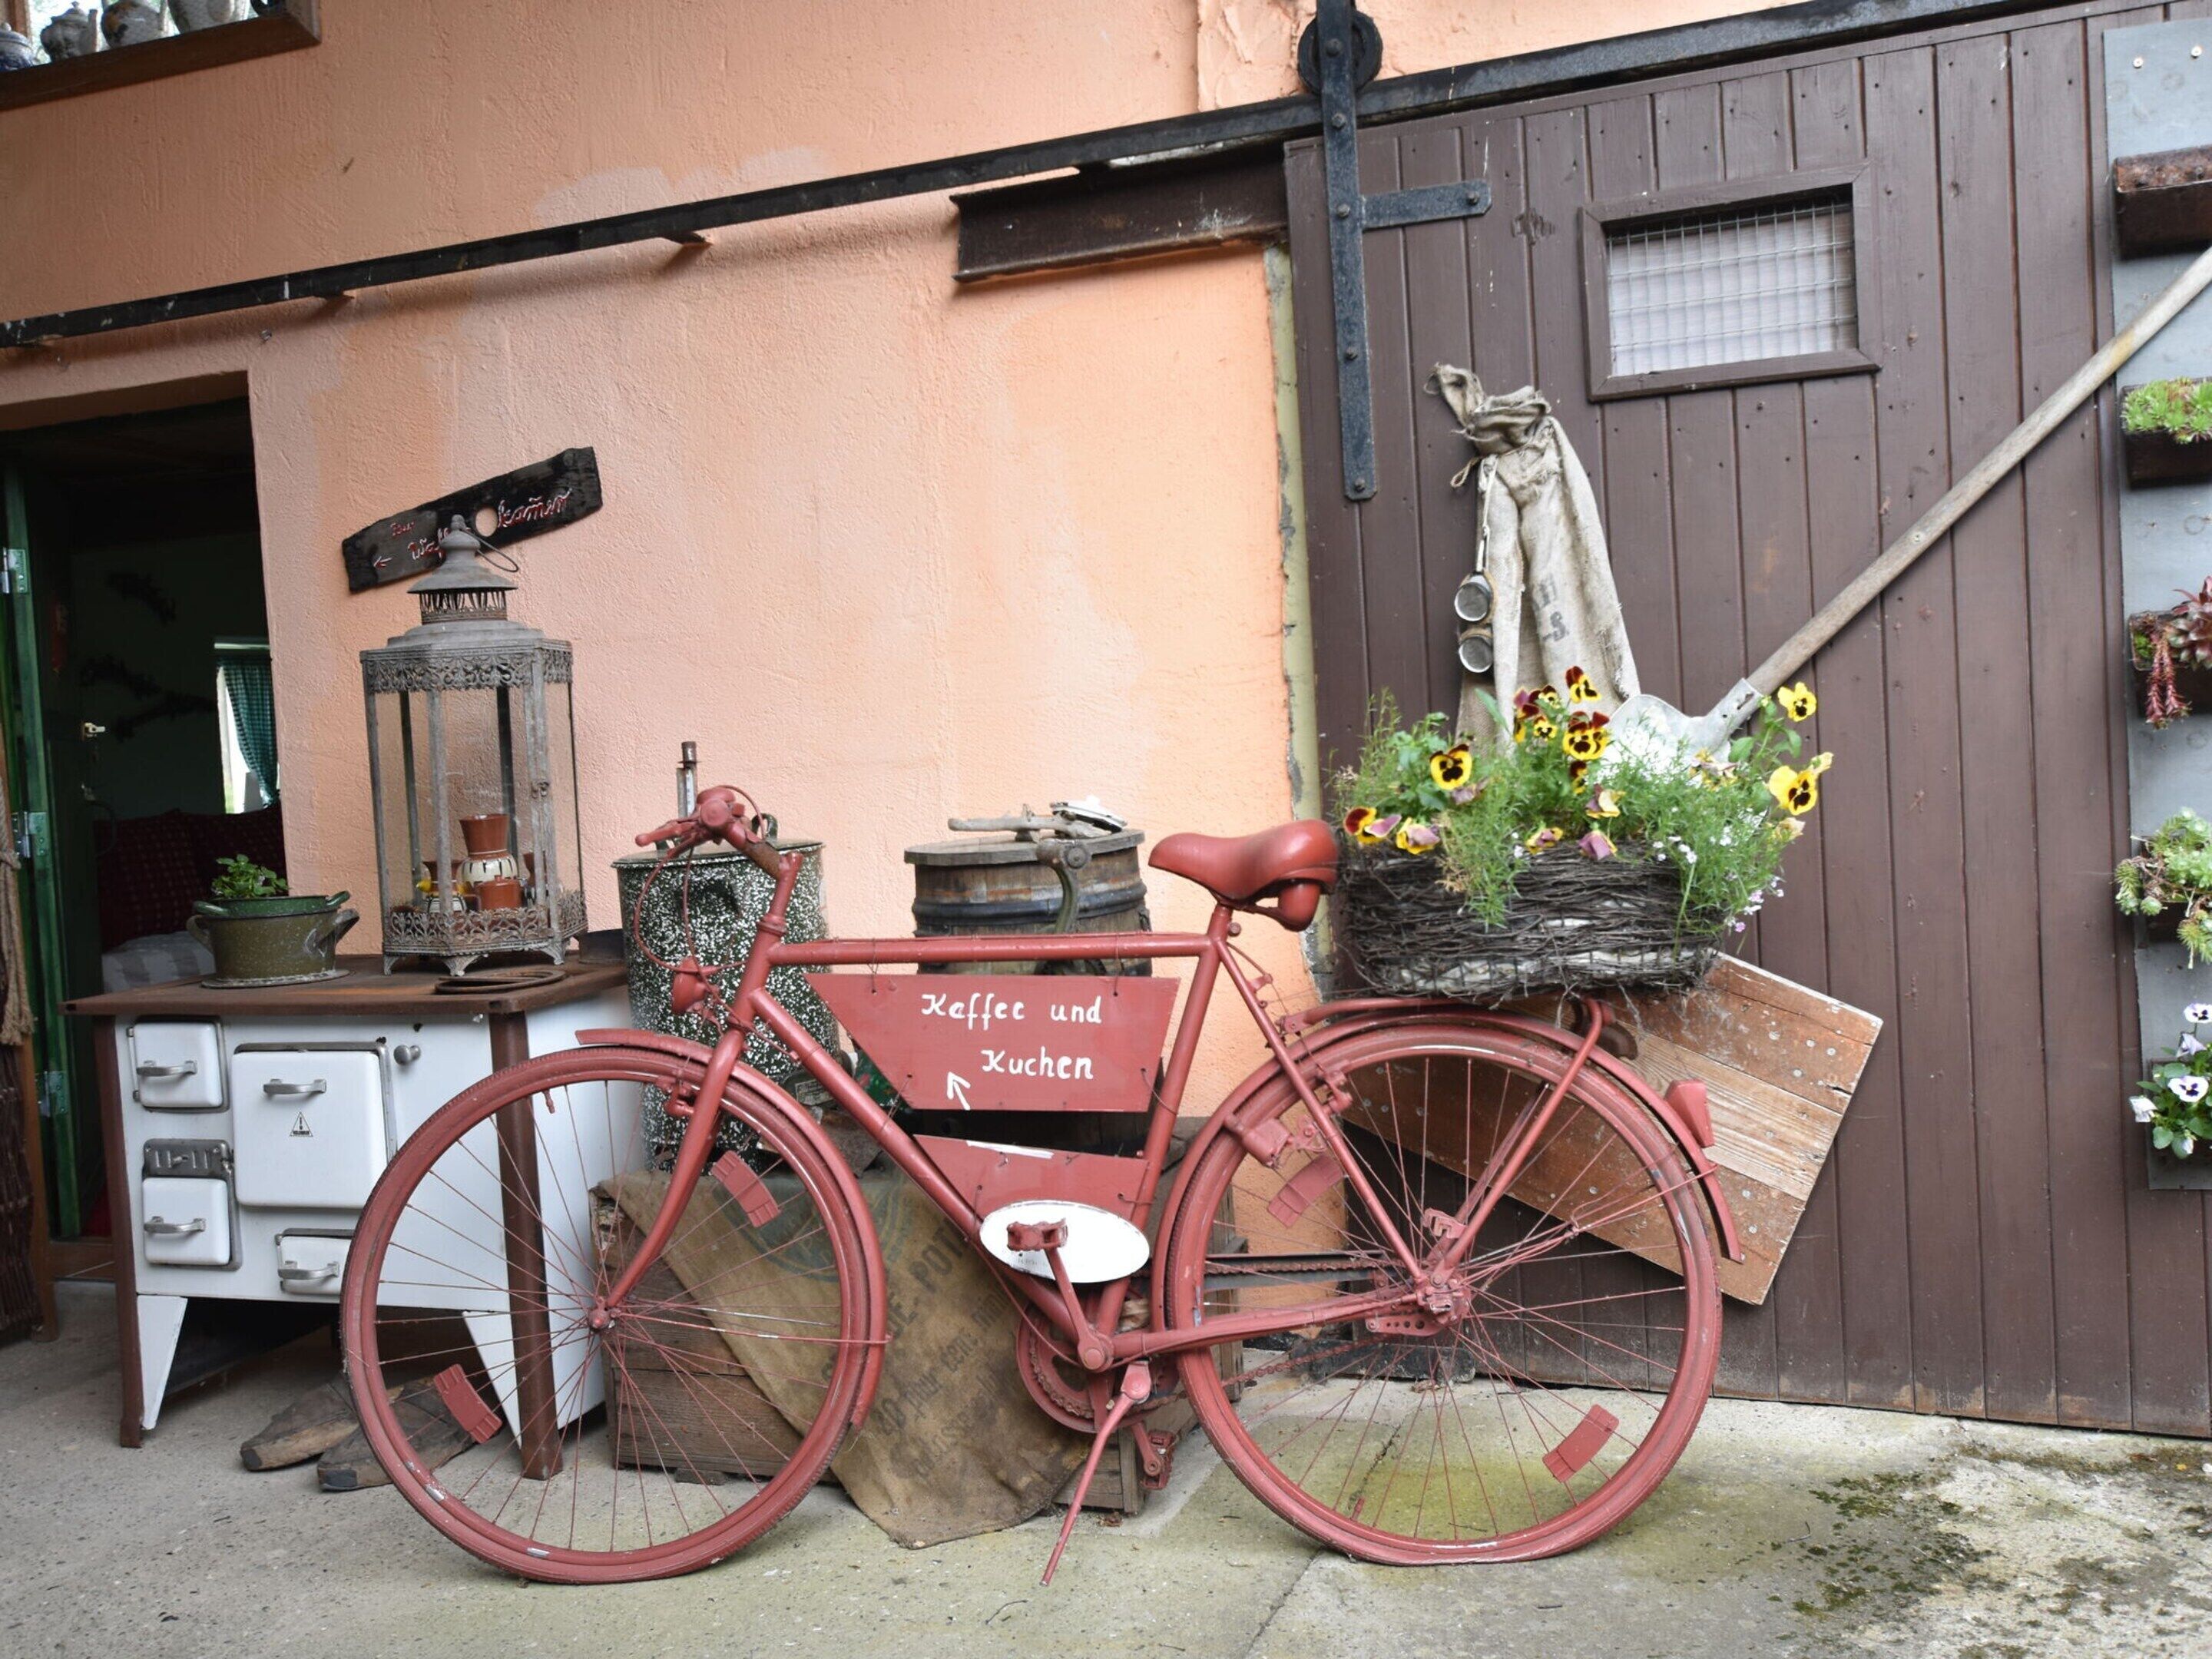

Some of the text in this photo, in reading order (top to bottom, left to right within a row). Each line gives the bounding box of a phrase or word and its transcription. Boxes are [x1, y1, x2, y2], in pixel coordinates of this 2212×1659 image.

[921, 992, 1102, 1031] Kaffee und
[980, 1045, 1094, 1080] Kuchen
